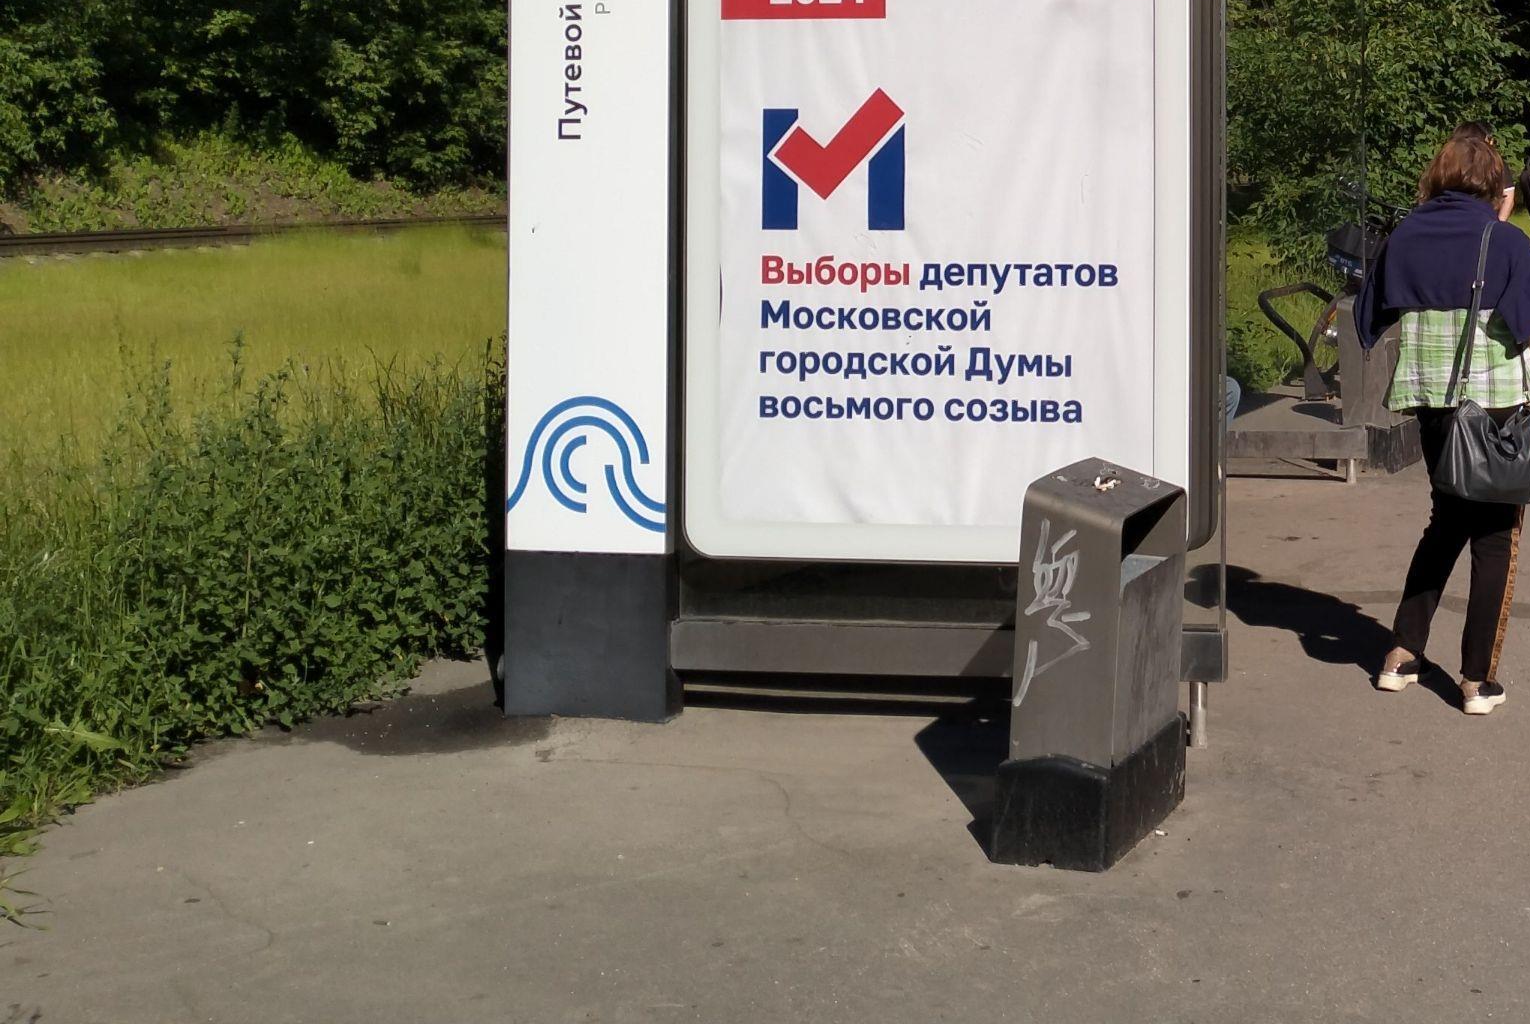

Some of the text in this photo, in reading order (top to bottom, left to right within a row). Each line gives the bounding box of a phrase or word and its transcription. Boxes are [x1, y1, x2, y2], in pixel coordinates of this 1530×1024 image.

[557, 3, 588, 141] Путевой
[760, 254, 1119, 295] Выборы депутатов
[760, 299, 992, 332] Московской
[758, 344, 1072, 385] городской Думы
[758, 395, 1083, 424] восьмого созыва
